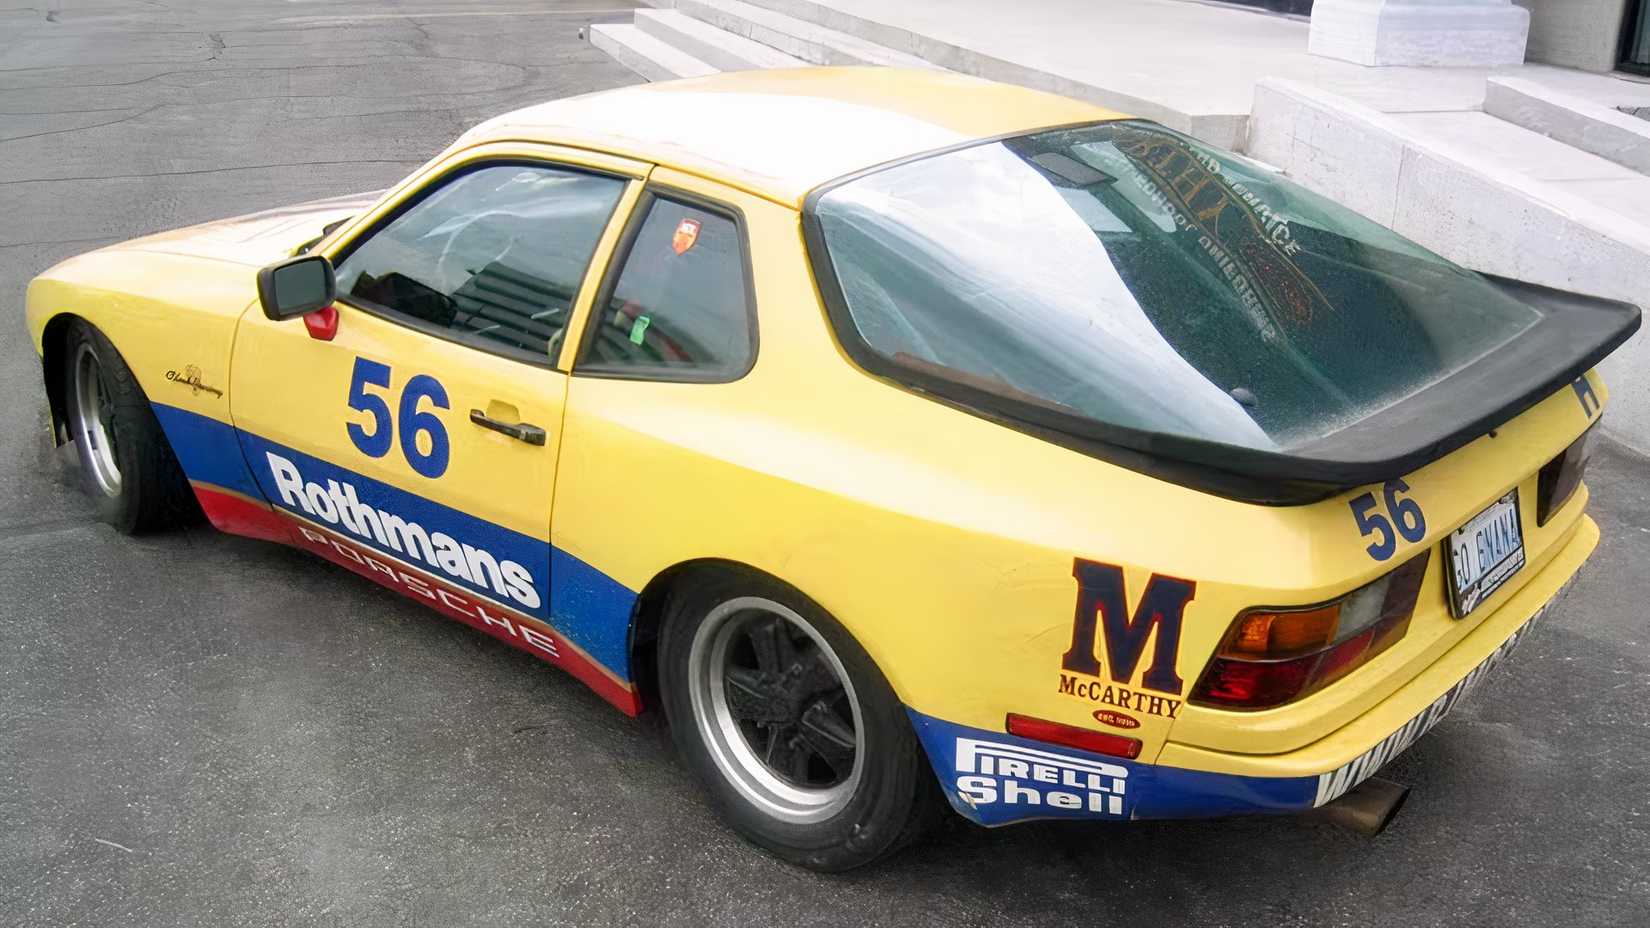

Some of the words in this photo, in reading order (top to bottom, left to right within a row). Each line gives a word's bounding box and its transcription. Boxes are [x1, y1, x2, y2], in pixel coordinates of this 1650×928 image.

[346, 355, 450, 479] 56
[266, 451, 541, 609] Rothmans
[1348, 478, 1427, 562] 56
[298, 526, 560, 658] PORSCHE
[1061, 556, 1197, 697] M
[1058, 673, 1182, 720] McCARTHY
[955, 736, 1129, 795] PIRELLI
[956, 775, 1123, 816] Shell
